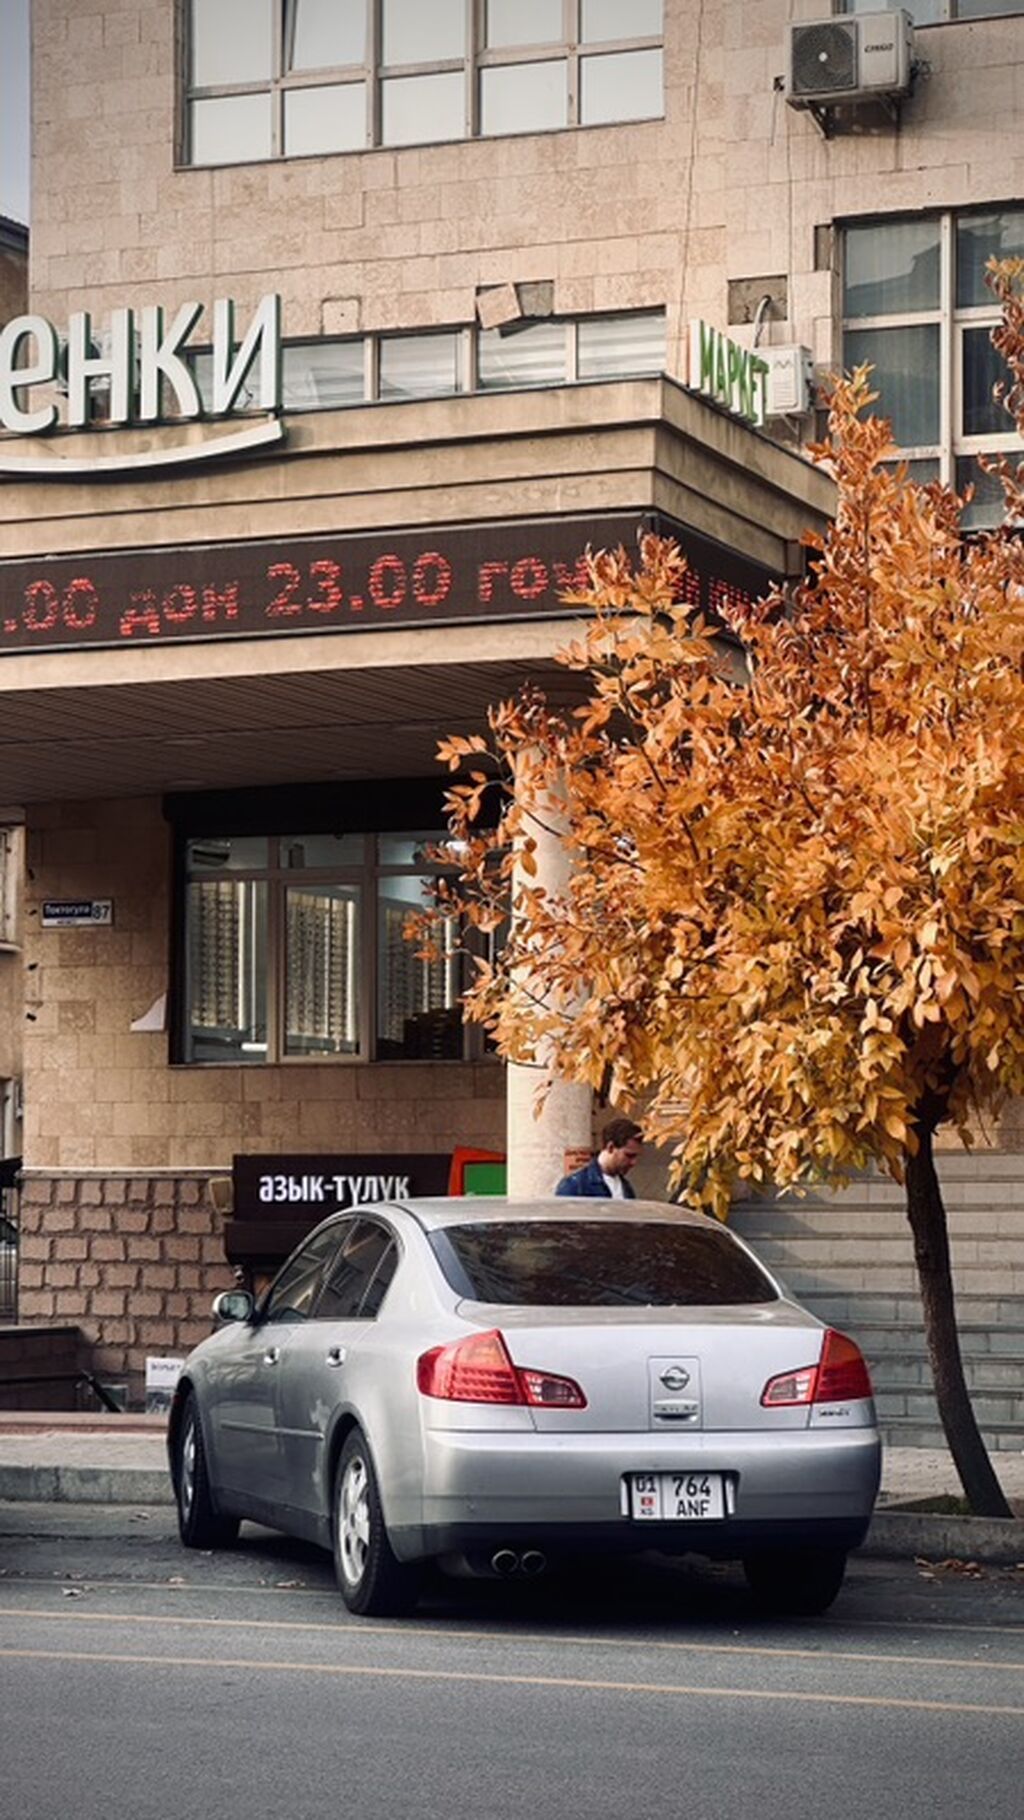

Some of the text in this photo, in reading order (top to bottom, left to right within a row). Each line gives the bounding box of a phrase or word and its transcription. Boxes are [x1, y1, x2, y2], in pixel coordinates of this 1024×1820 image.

[265, 552, 453, 617] 23.00
[635, 1475, 711, 1497] 01 764
[676, 1500, 710, 1516] ANF
